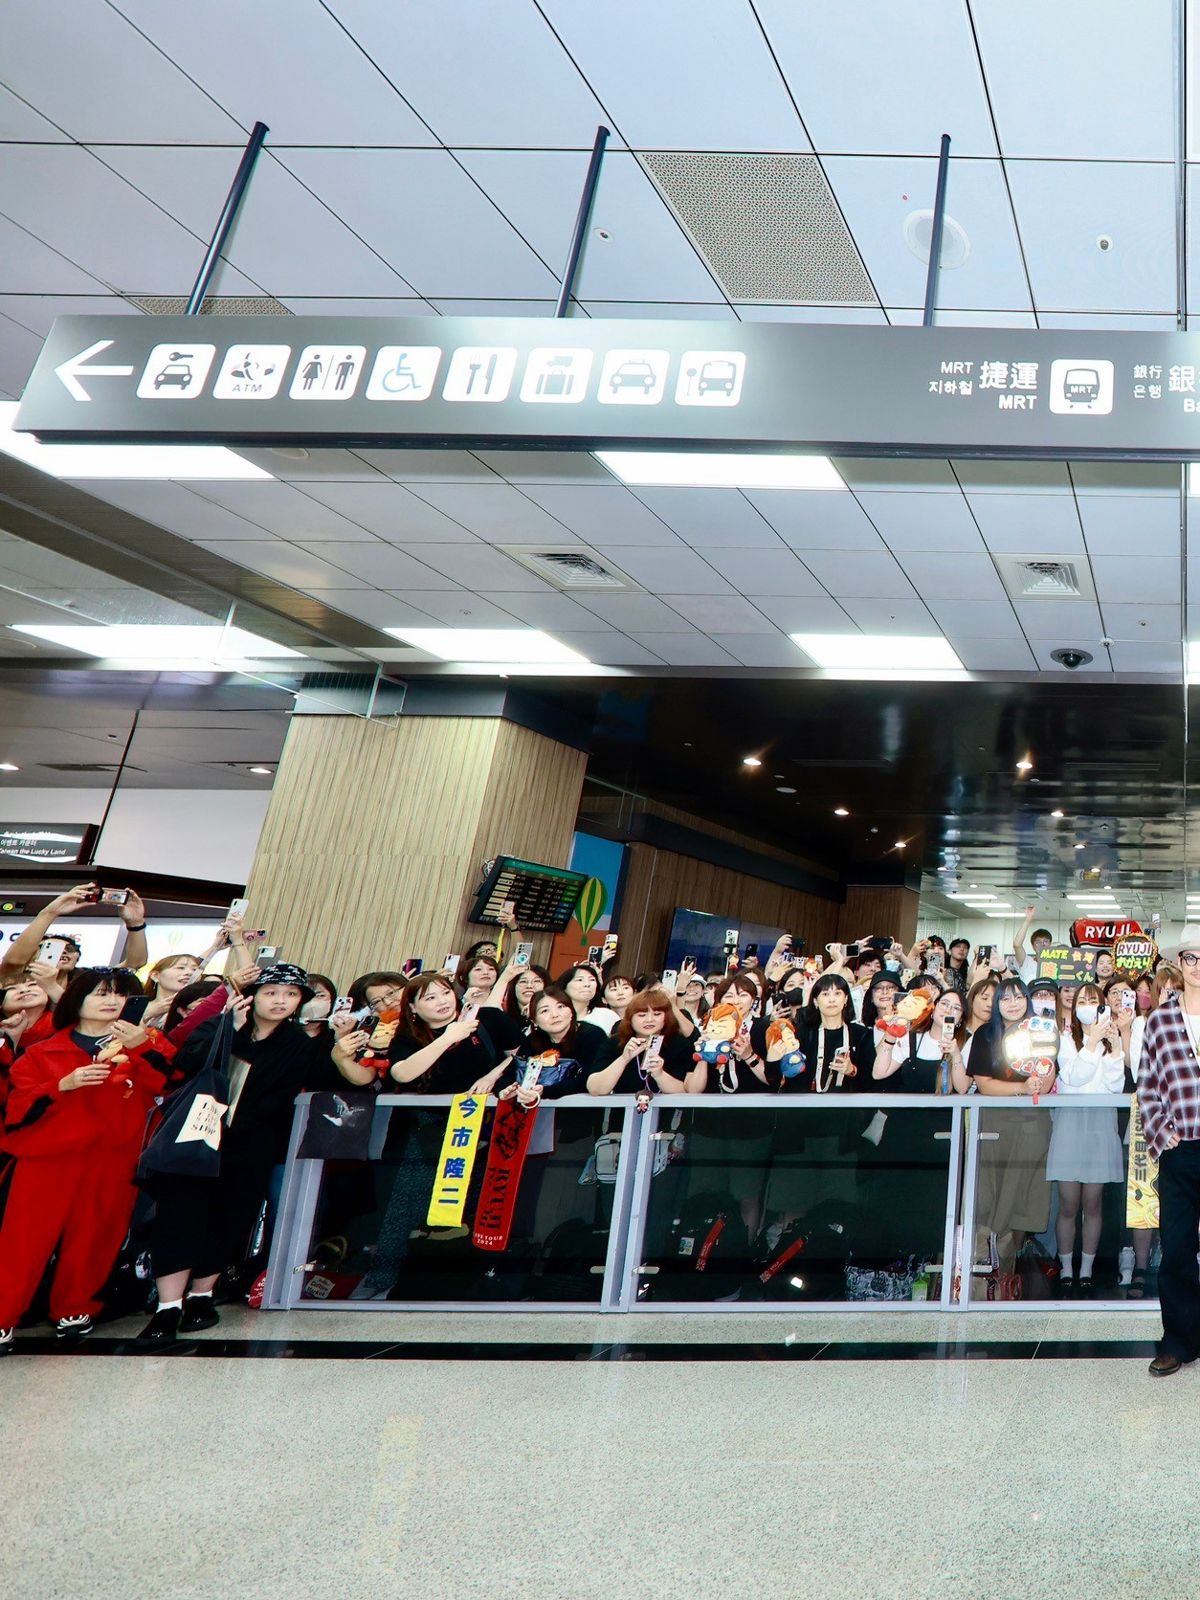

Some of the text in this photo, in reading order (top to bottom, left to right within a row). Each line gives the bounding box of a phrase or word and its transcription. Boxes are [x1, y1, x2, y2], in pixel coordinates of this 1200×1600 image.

[941, 361, 974, 374] MRT
[1133, 364, 1163, 379] 銀行
[979, 361, 1039, 390] 捷運
[231, 384, 262, 392] ATM
[928, 380, 973, 395] 지하철
[1070, 385, 1093, 394] MRT
[1133, 384, 1162, 399] 은행
[998, 395, 1038, 409] MRT
[1085, 923, 1132, 938] RYUJI
[1040, 949, 1069, 960] MATE
[1116, 942, 1152, 956] RYUJI
[438, 1097, 478, 1205] 今市隆二
